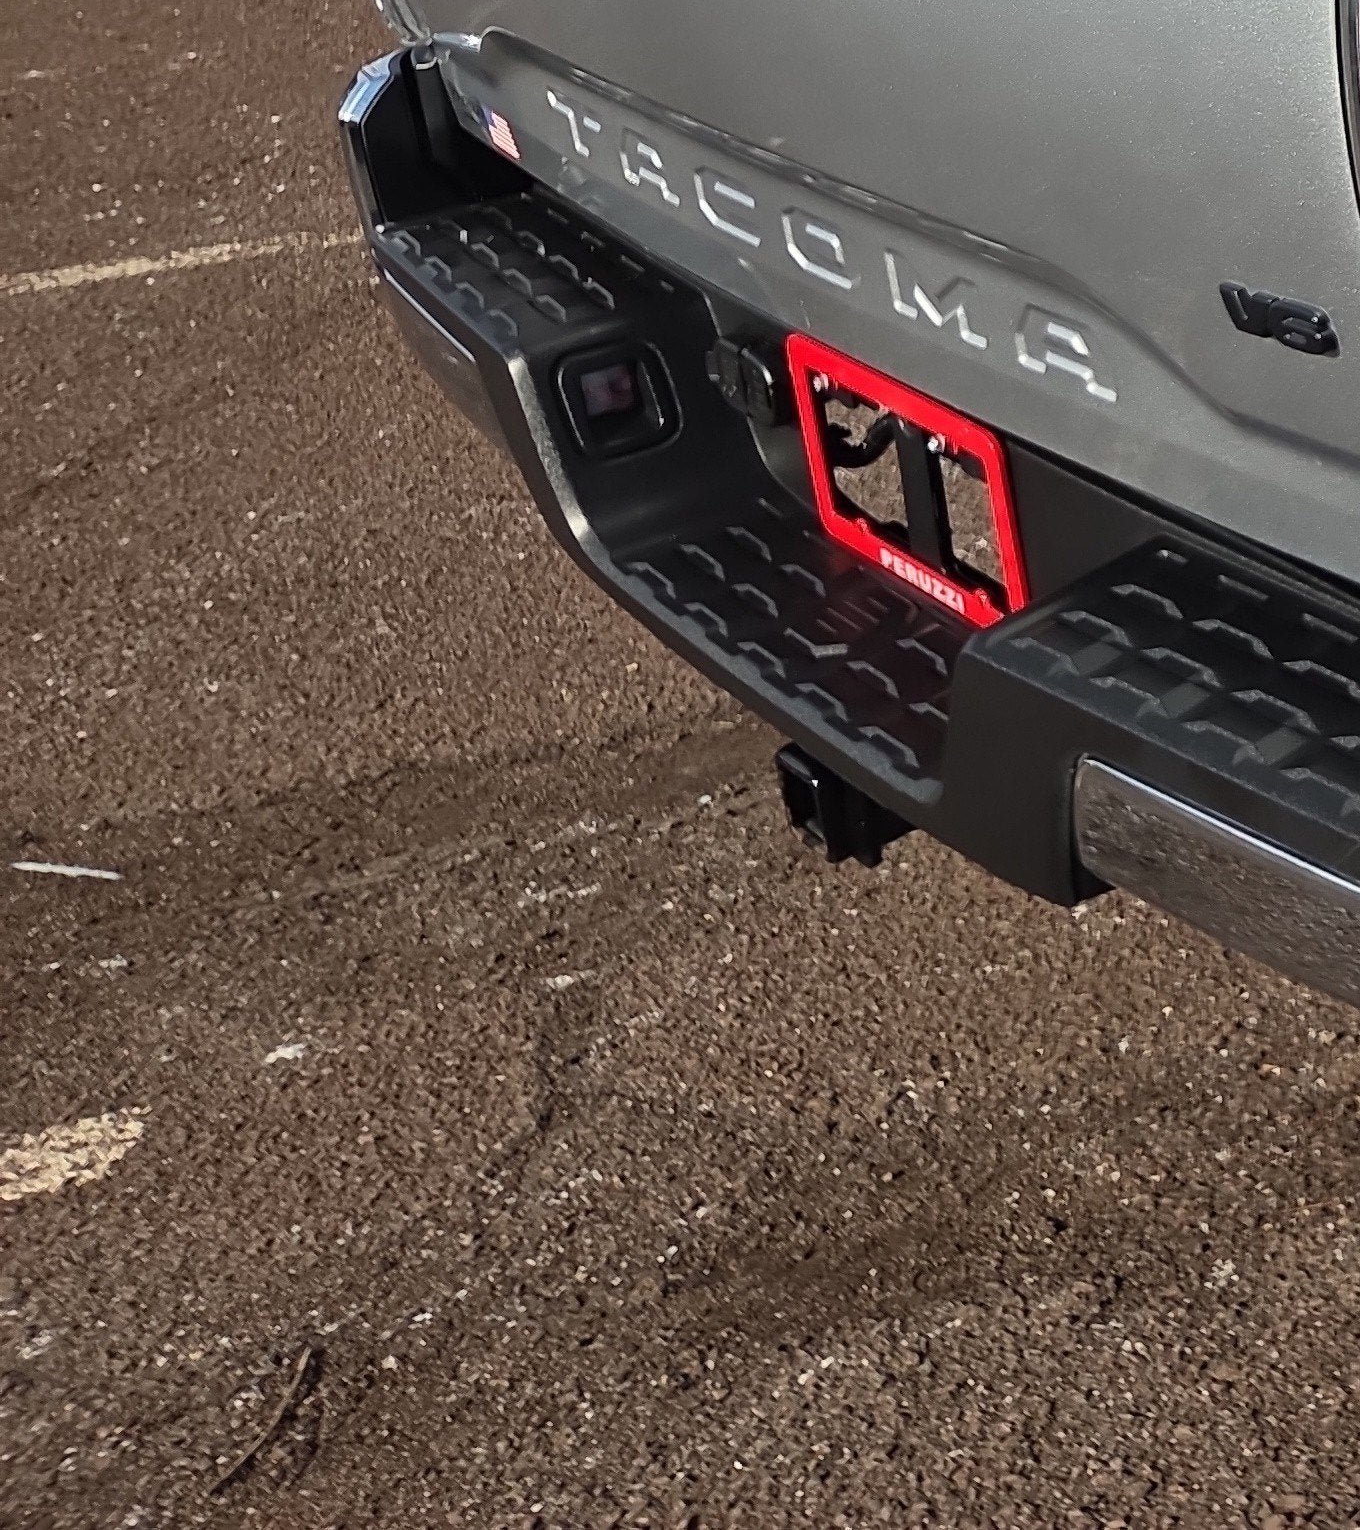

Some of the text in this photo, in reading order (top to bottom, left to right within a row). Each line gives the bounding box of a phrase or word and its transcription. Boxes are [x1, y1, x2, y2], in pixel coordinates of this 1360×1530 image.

[546, 87, 1118, 404] TACOMA
[1219, 279, 1340, 358] V6
[880, 547, 965, 615] PERUZZI
